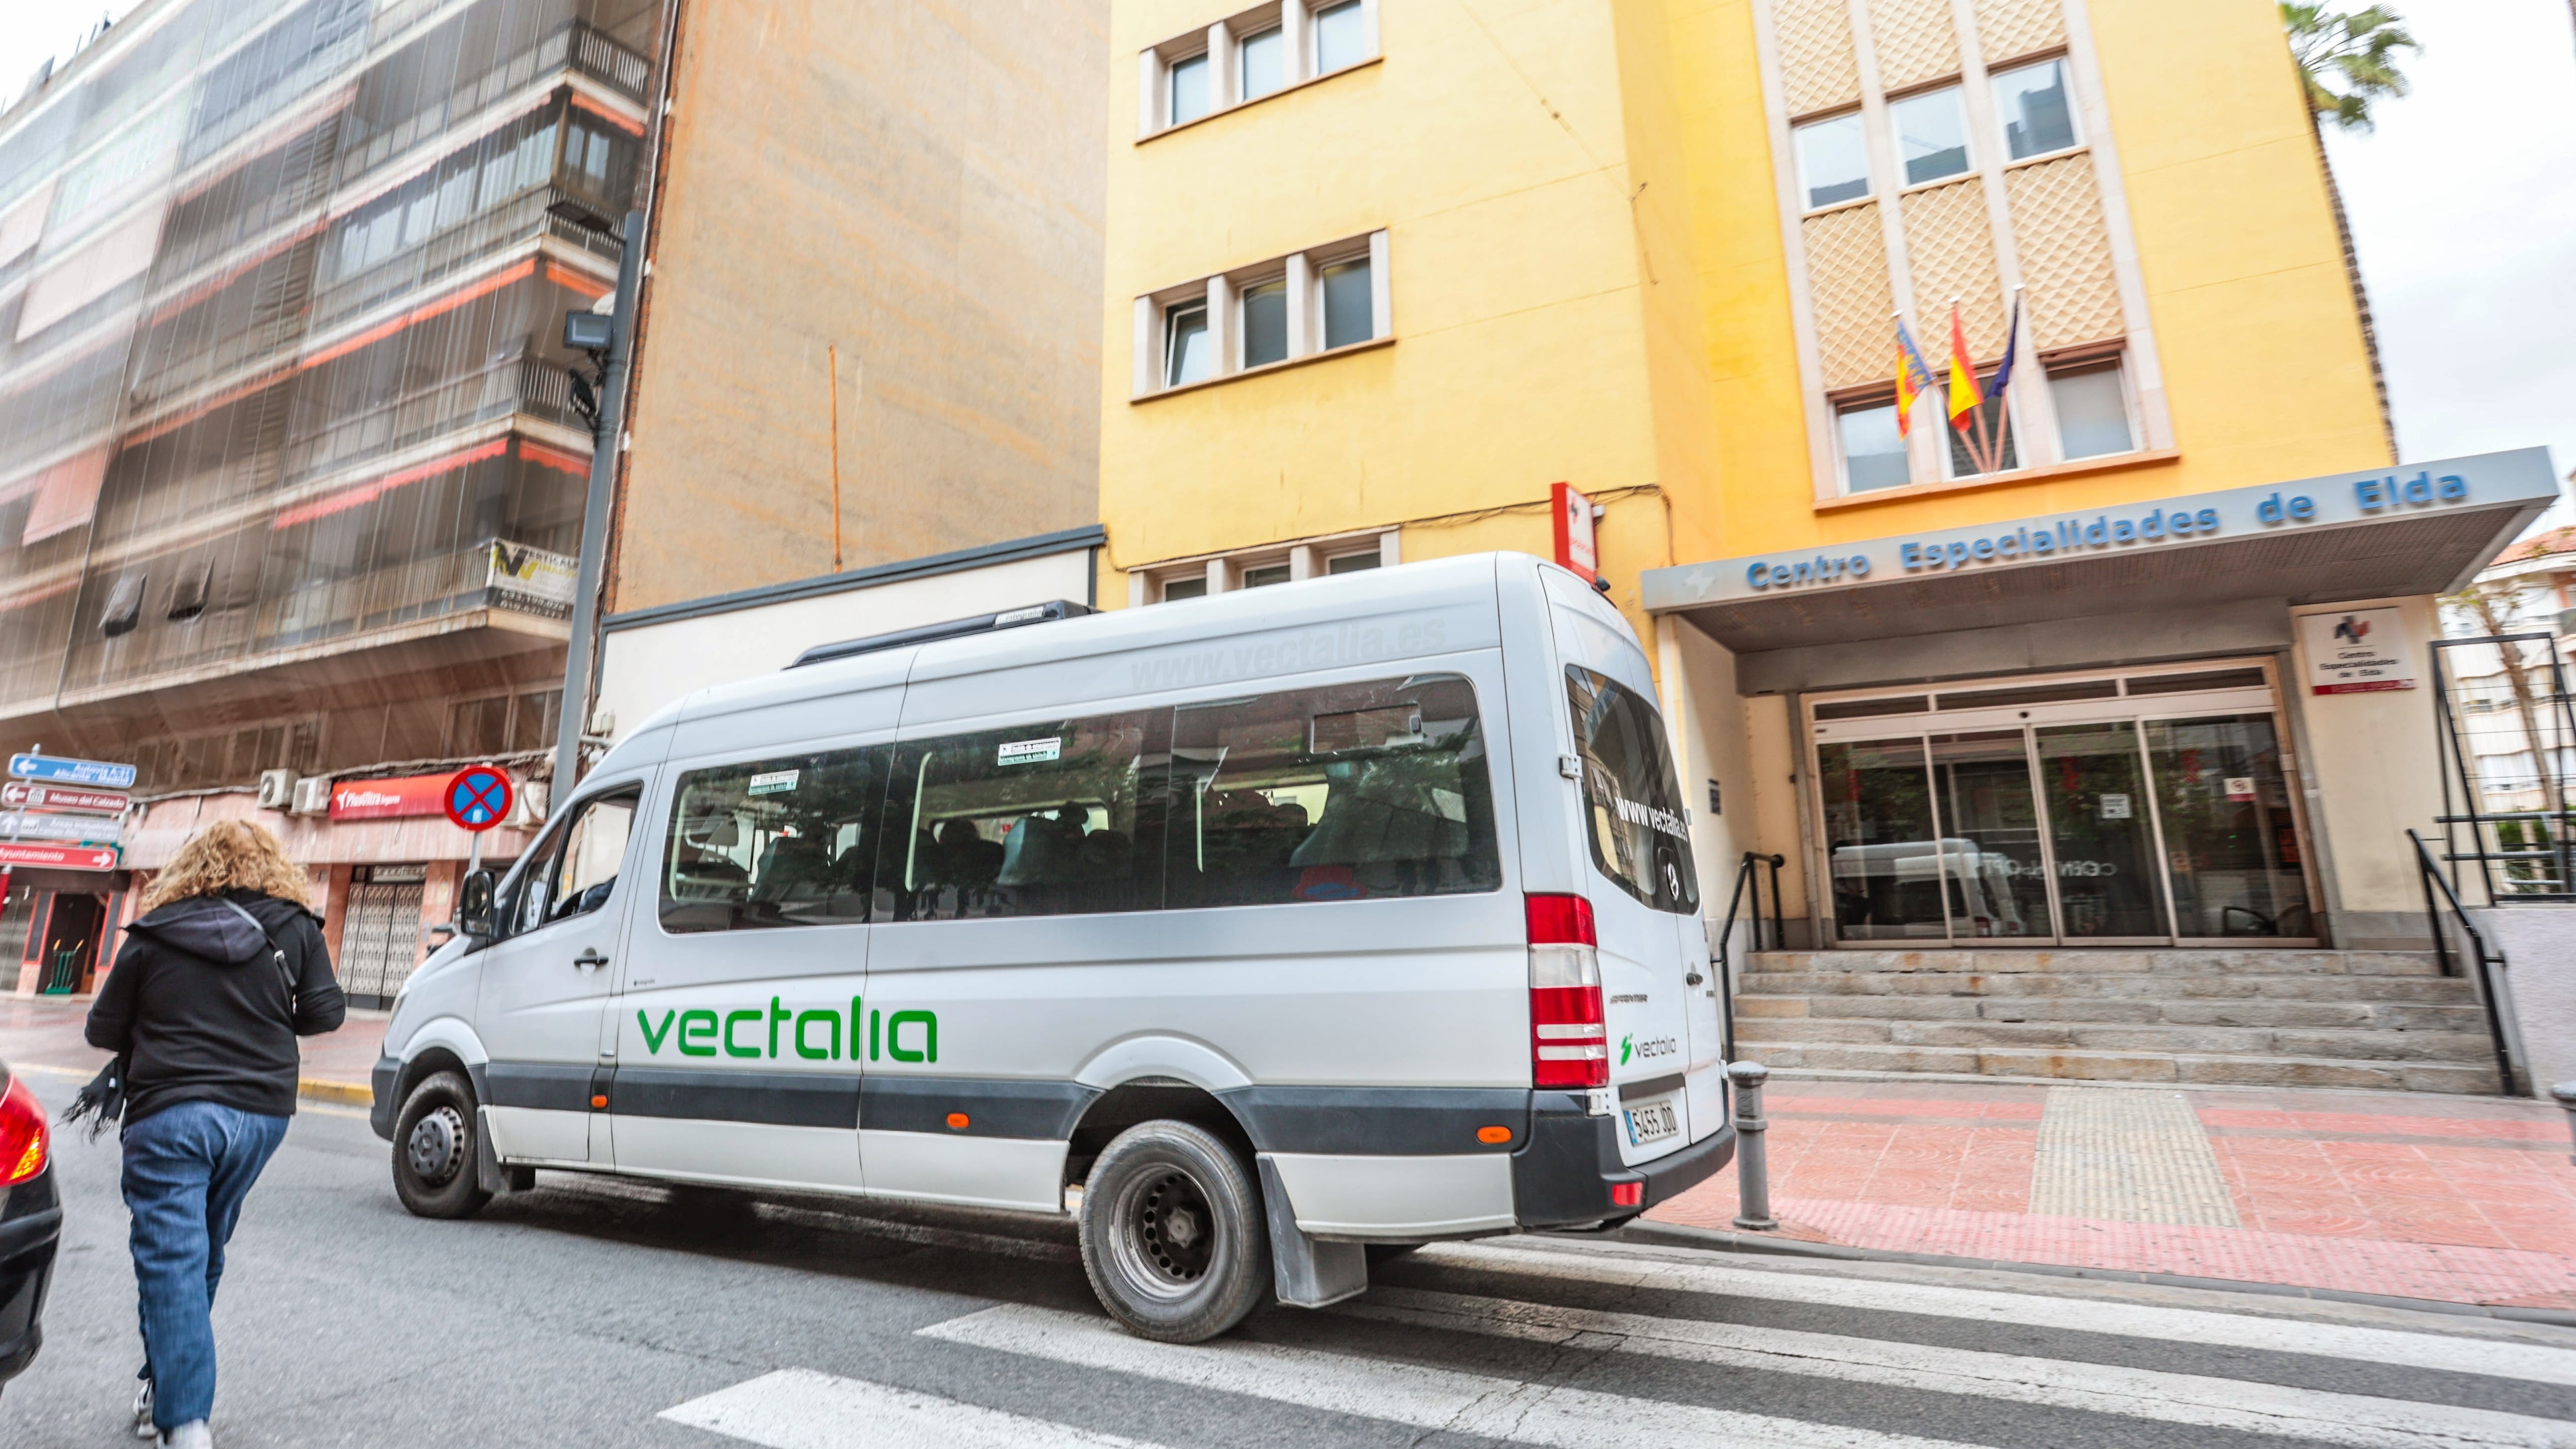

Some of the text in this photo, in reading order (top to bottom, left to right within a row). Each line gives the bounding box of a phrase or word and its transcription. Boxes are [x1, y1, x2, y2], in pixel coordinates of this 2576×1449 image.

[1747, 471, 2469, 587] Centro Especialidades de Elda
[1130, 618, 1446, 689] www.vectalia.es
[49, 793, 125, 808] Museo del Calzado
[637, 996, 938, 1063] vectalia
[1635, 1035, 1676, 1058] vectalia
[1632, 1109, 1660, 1142] 5455
